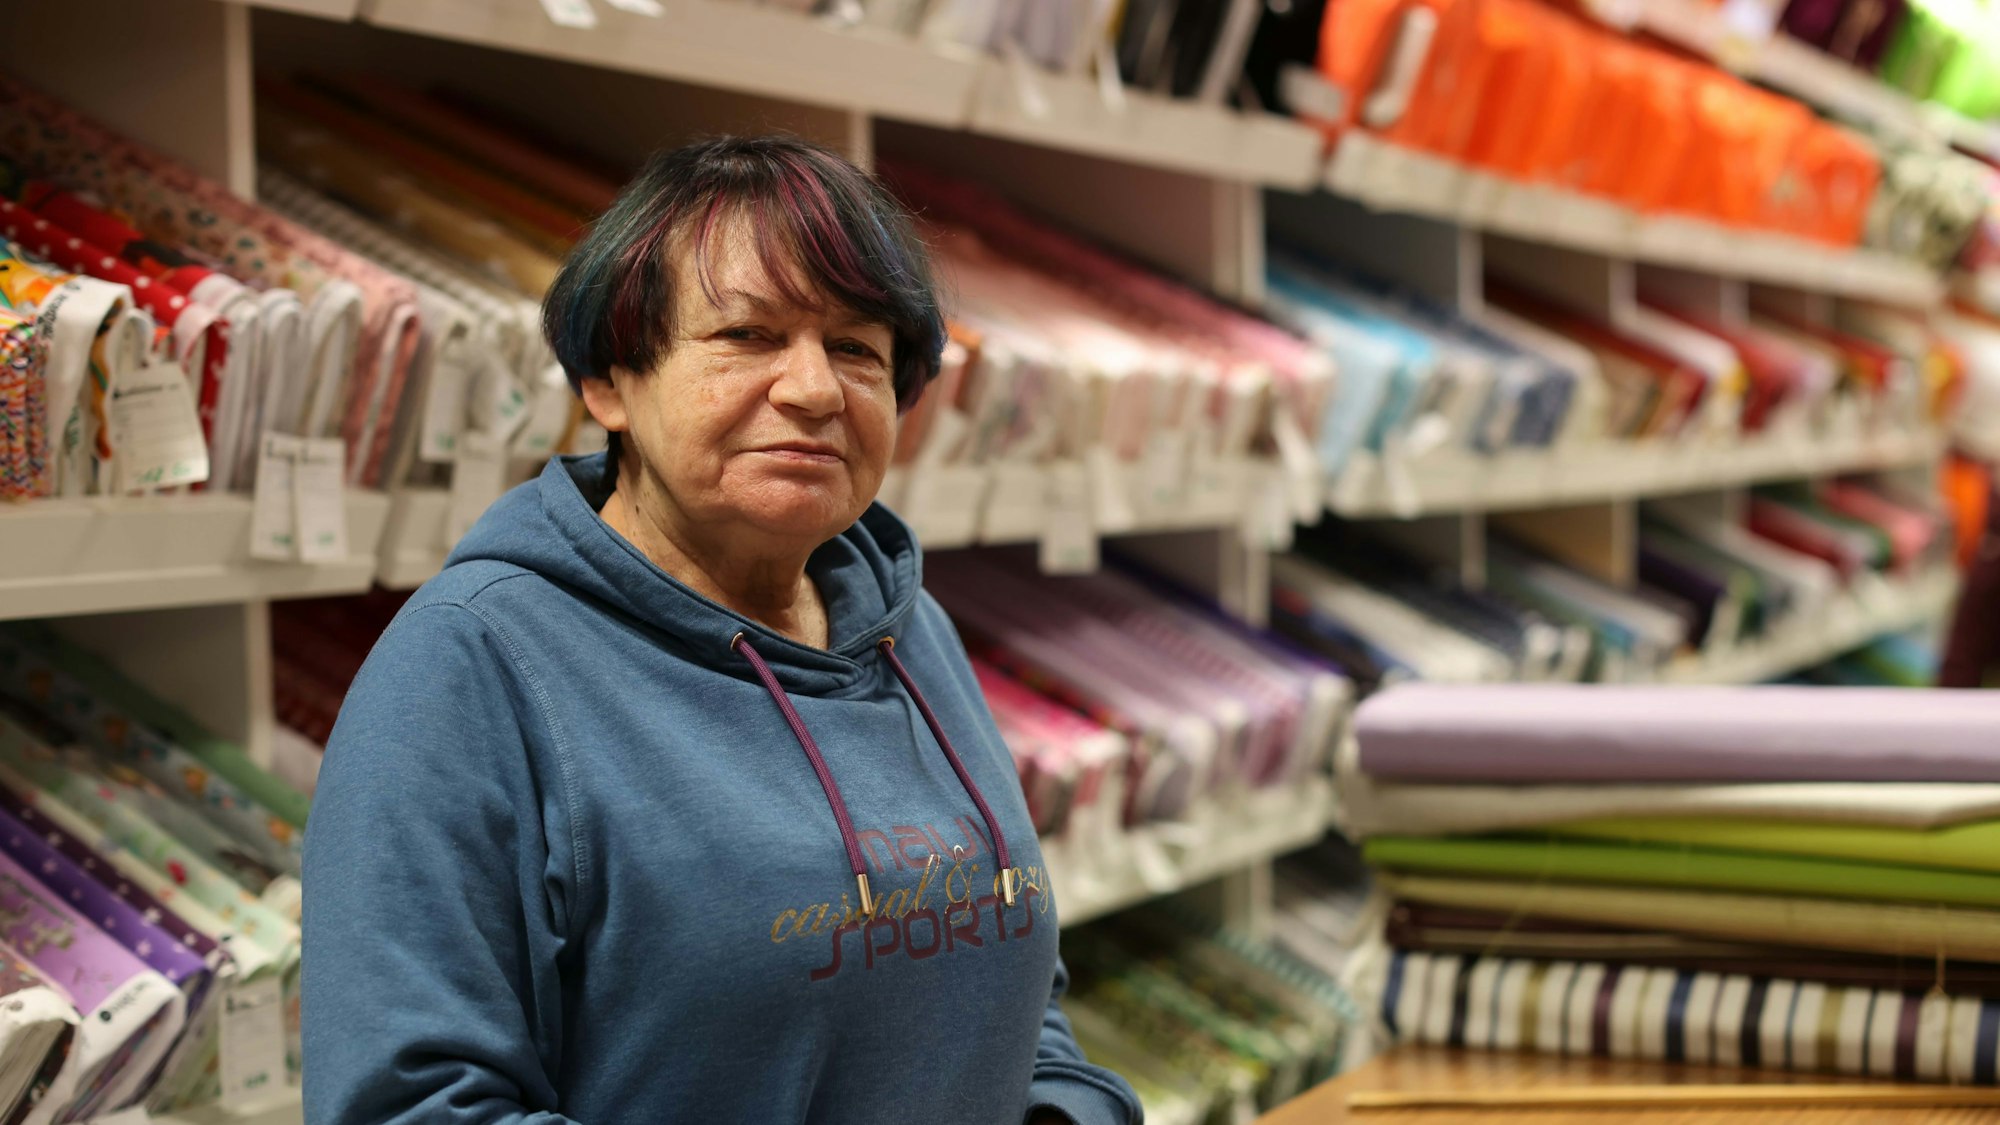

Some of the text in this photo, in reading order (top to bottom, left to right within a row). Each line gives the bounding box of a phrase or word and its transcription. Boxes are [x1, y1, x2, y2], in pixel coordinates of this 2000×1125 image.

[770, 854, 940, 944] casual
[945, 845, 980, 924] &
[810, 887, 1039, 981] SPORTS
